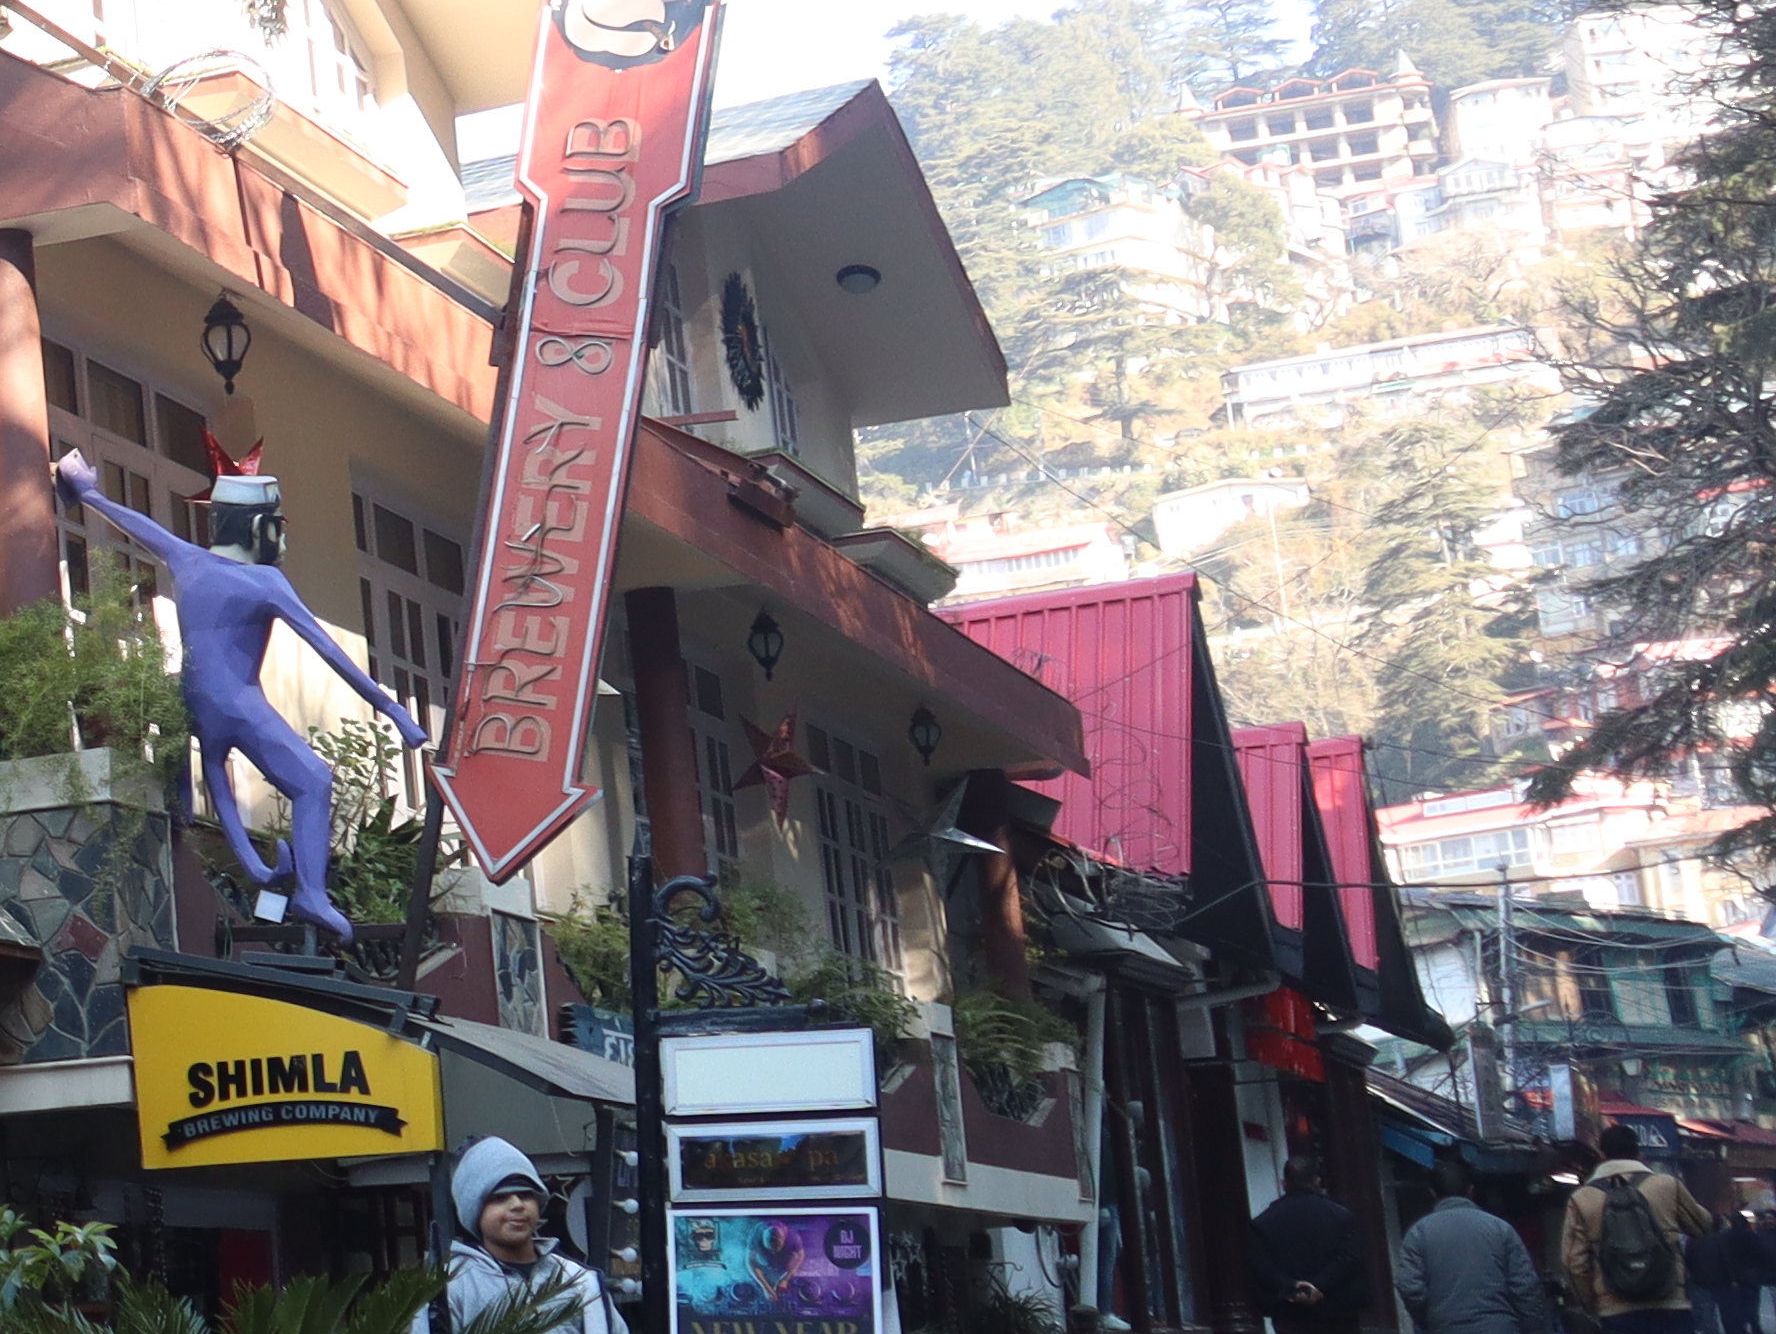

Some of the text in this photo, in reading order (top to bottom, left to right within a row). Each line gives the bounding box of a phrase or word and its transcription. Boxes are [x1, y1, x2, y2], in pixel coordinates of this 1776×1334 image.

[471, 393, 602, 763] BREWERY
[548, 117, 643, 309] CLUB
[187, 1050, 371, 1108] SHIMLA
[183, 1103, 380, 1139] BREWING COMPANY
[832, 1245, 862, 1259] NIGHT
[840, 1230, 854, 1244] DJ
